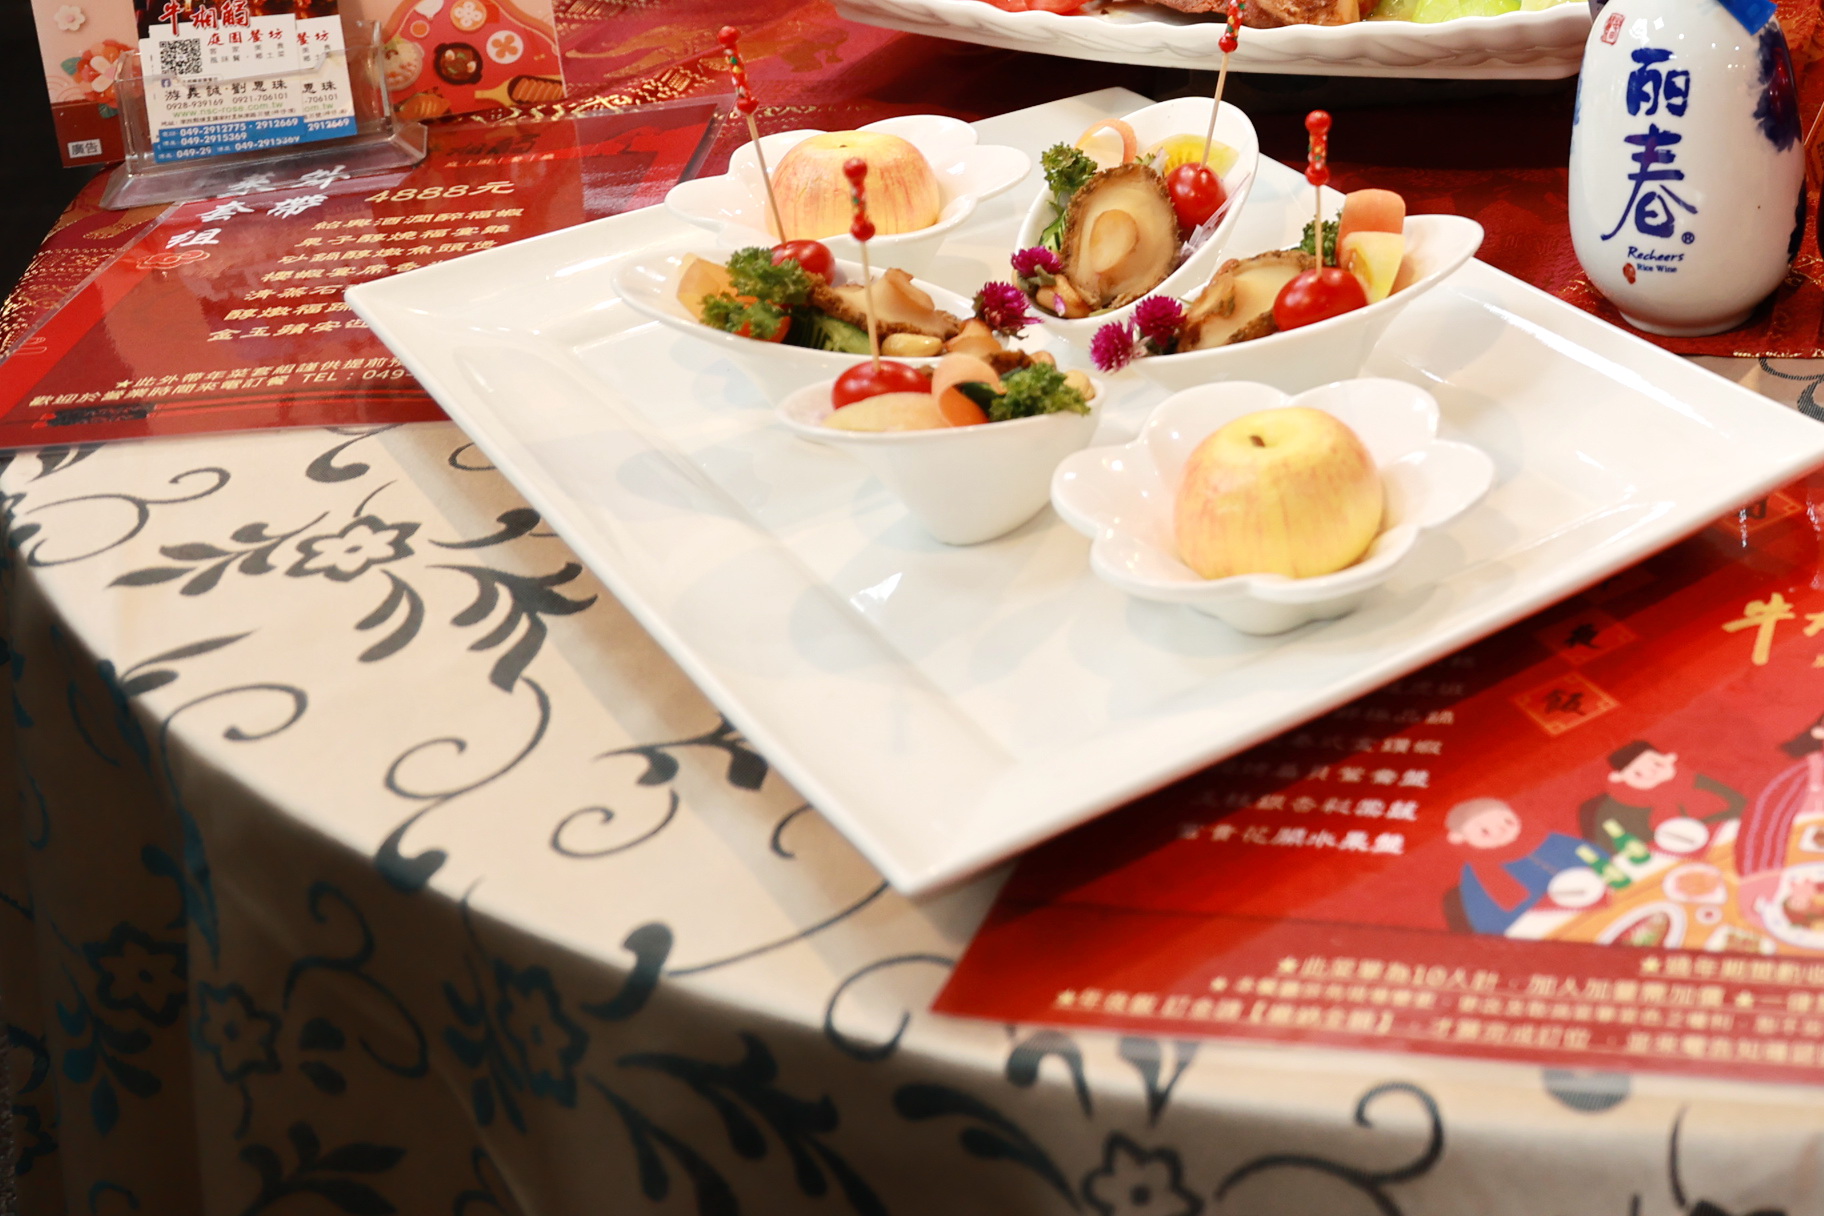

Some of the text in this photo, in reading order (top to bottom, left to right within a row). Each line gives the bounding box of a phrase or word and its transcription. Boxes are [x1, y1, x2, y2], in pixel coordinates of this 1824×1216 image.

[179, 122, 247, 138] 049-2912775
[71, 142, 99, 155] 廣告
[365, 180, 515, 204] 4888元
[1627, 246, 1685, 263] Recheers
[1636, 263, 1678, 274] Rice Wine
